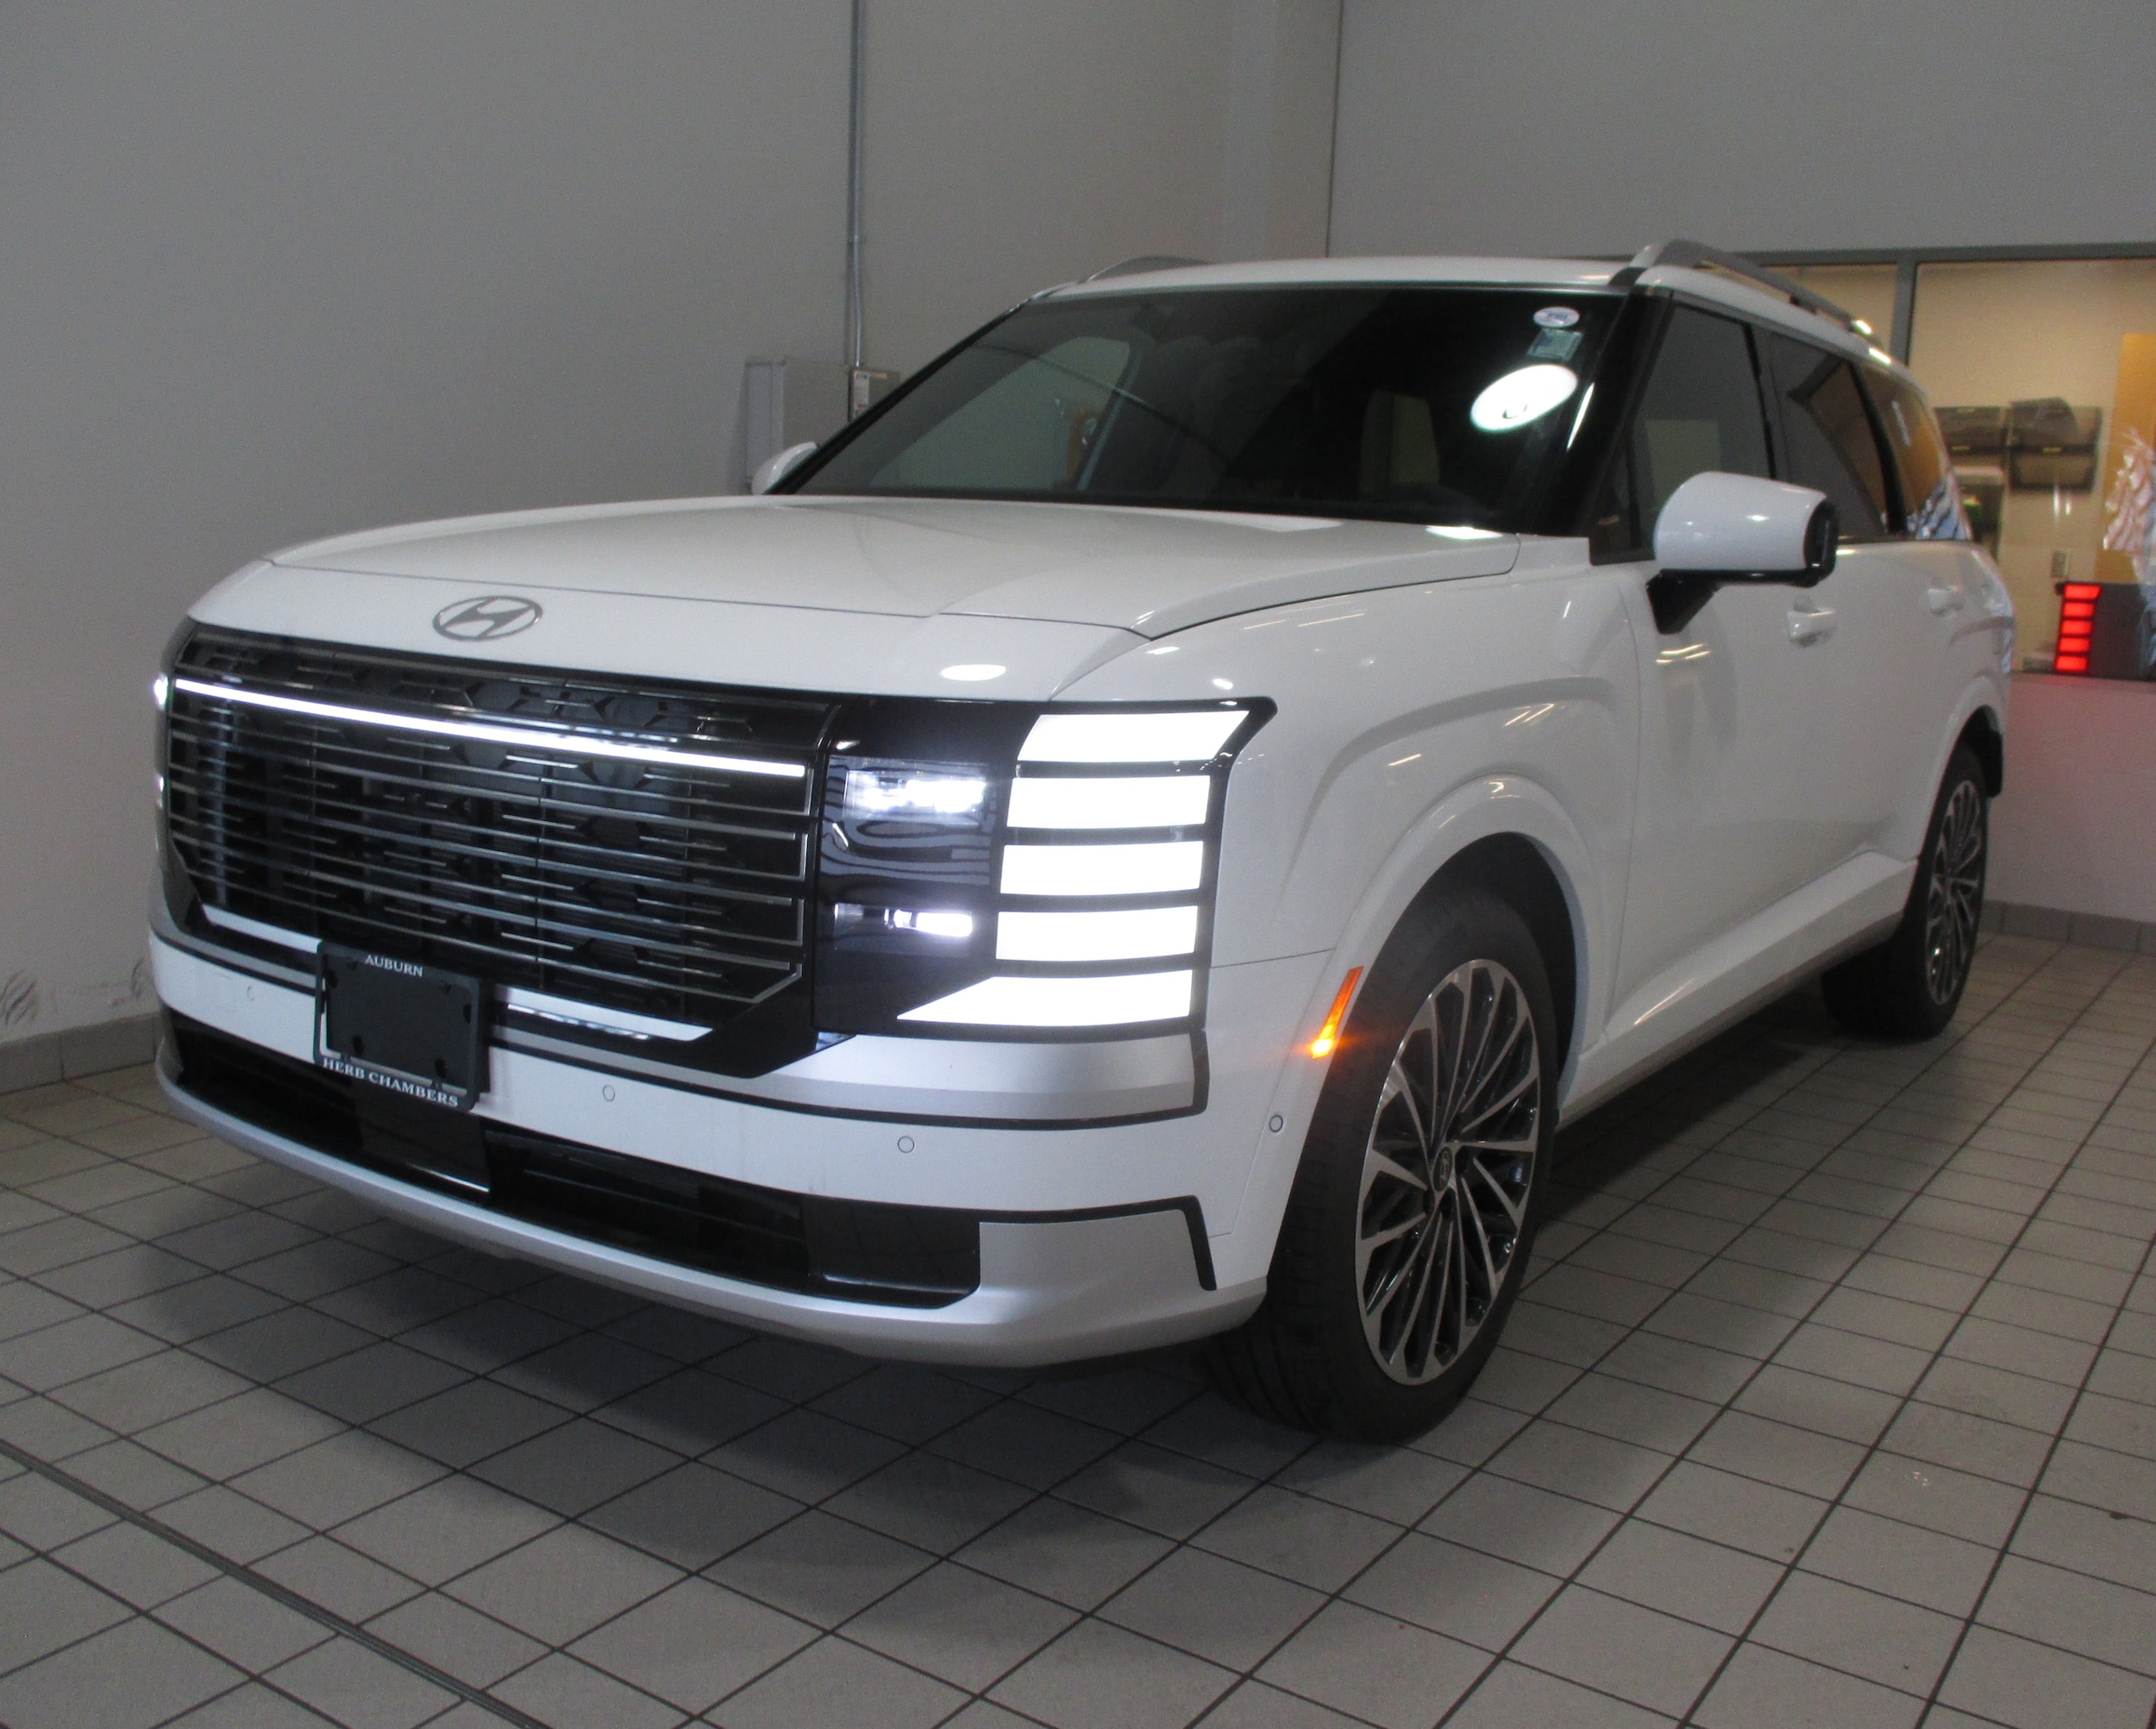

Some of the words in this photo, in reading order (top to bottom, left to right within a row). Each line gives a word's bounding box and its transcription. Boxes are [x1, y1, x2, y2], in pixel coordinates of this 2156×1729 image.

[365, 954, 423, 977] AUBURN
[323, 1057, 365, 1080] HERB
[368, 1071, 459, 1108] CHAMBERS
